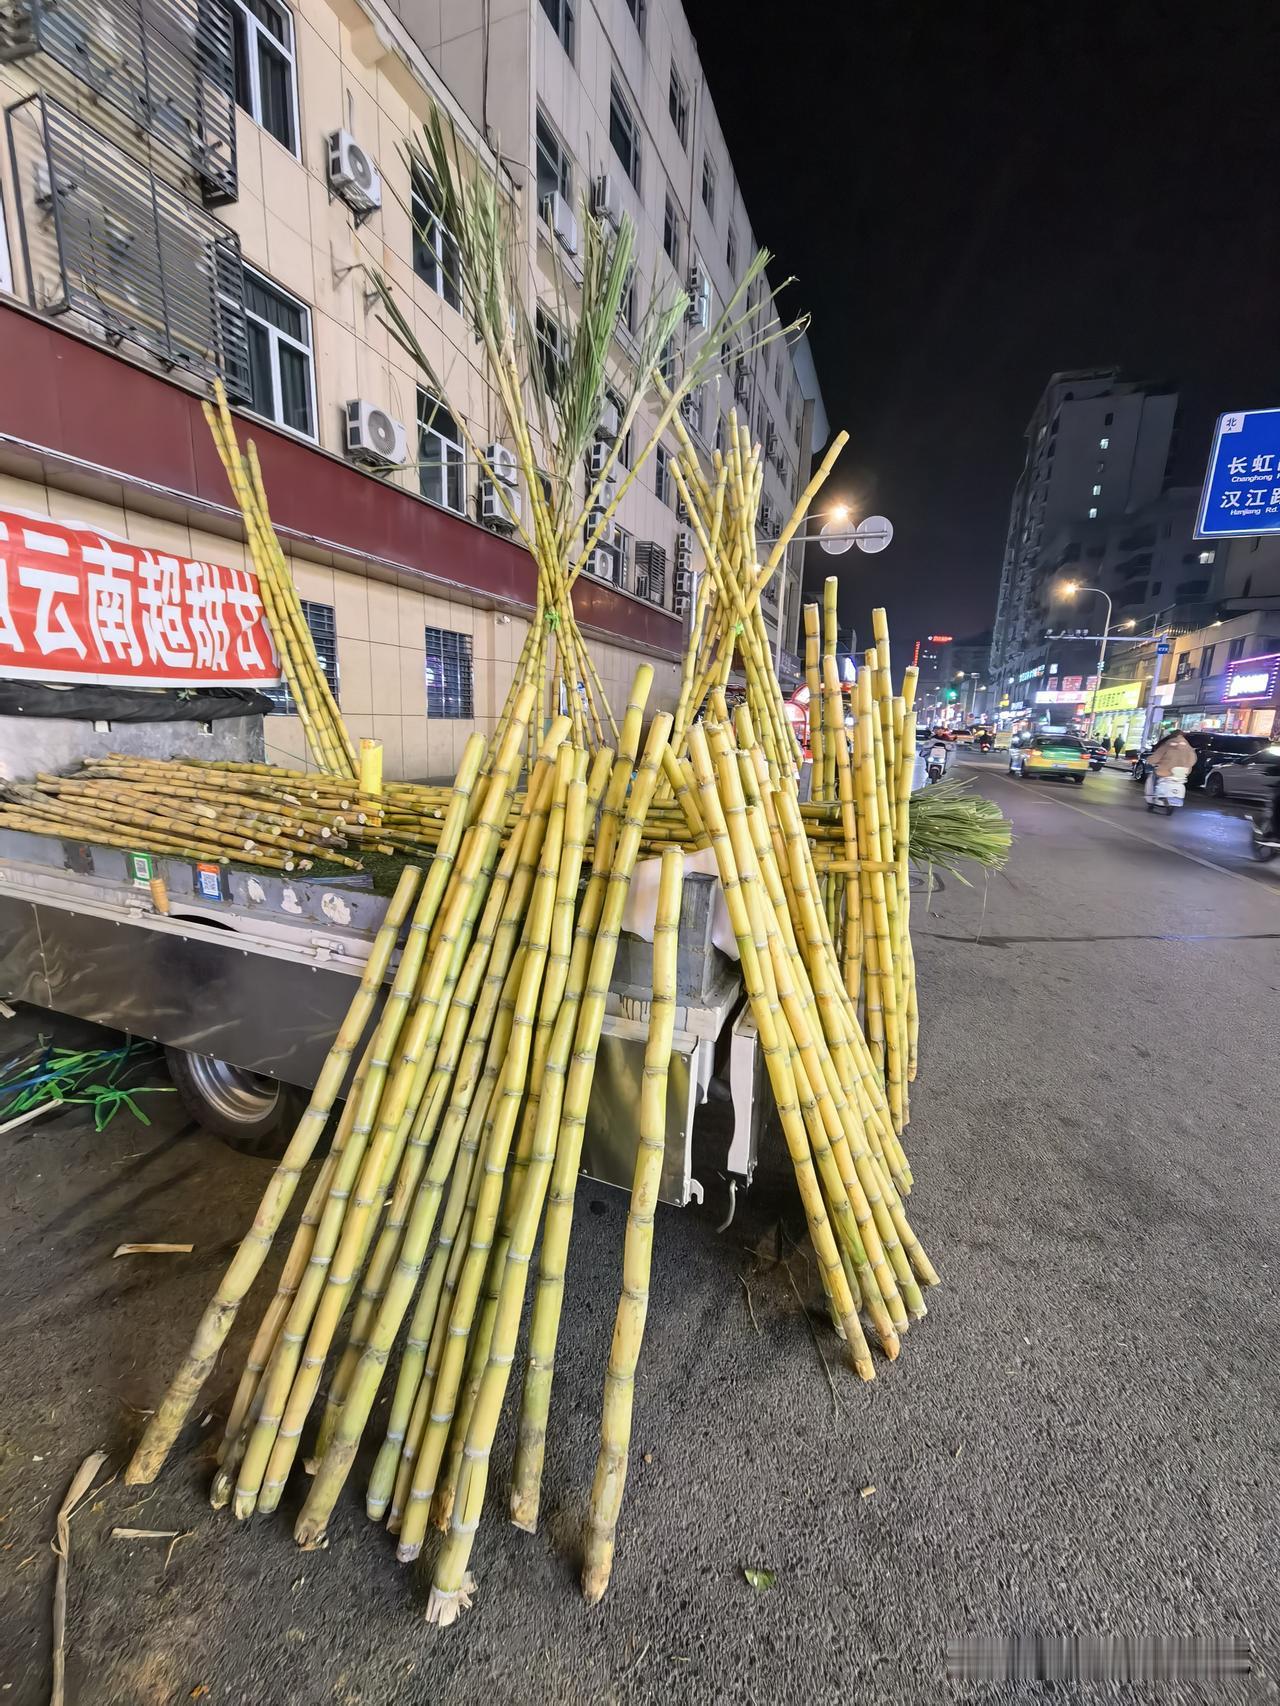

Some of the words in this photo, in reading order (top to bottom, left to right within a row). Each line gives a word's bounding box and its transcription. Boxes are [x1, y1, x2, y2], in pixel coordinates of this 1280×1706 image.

[1226, 417, 1237, 427] 北
[1227, 454, 1280, 475] 长虹
[1231, 474, 1273, 483] Changhong
[0, 521, 280, 672] 云南超甜甘
